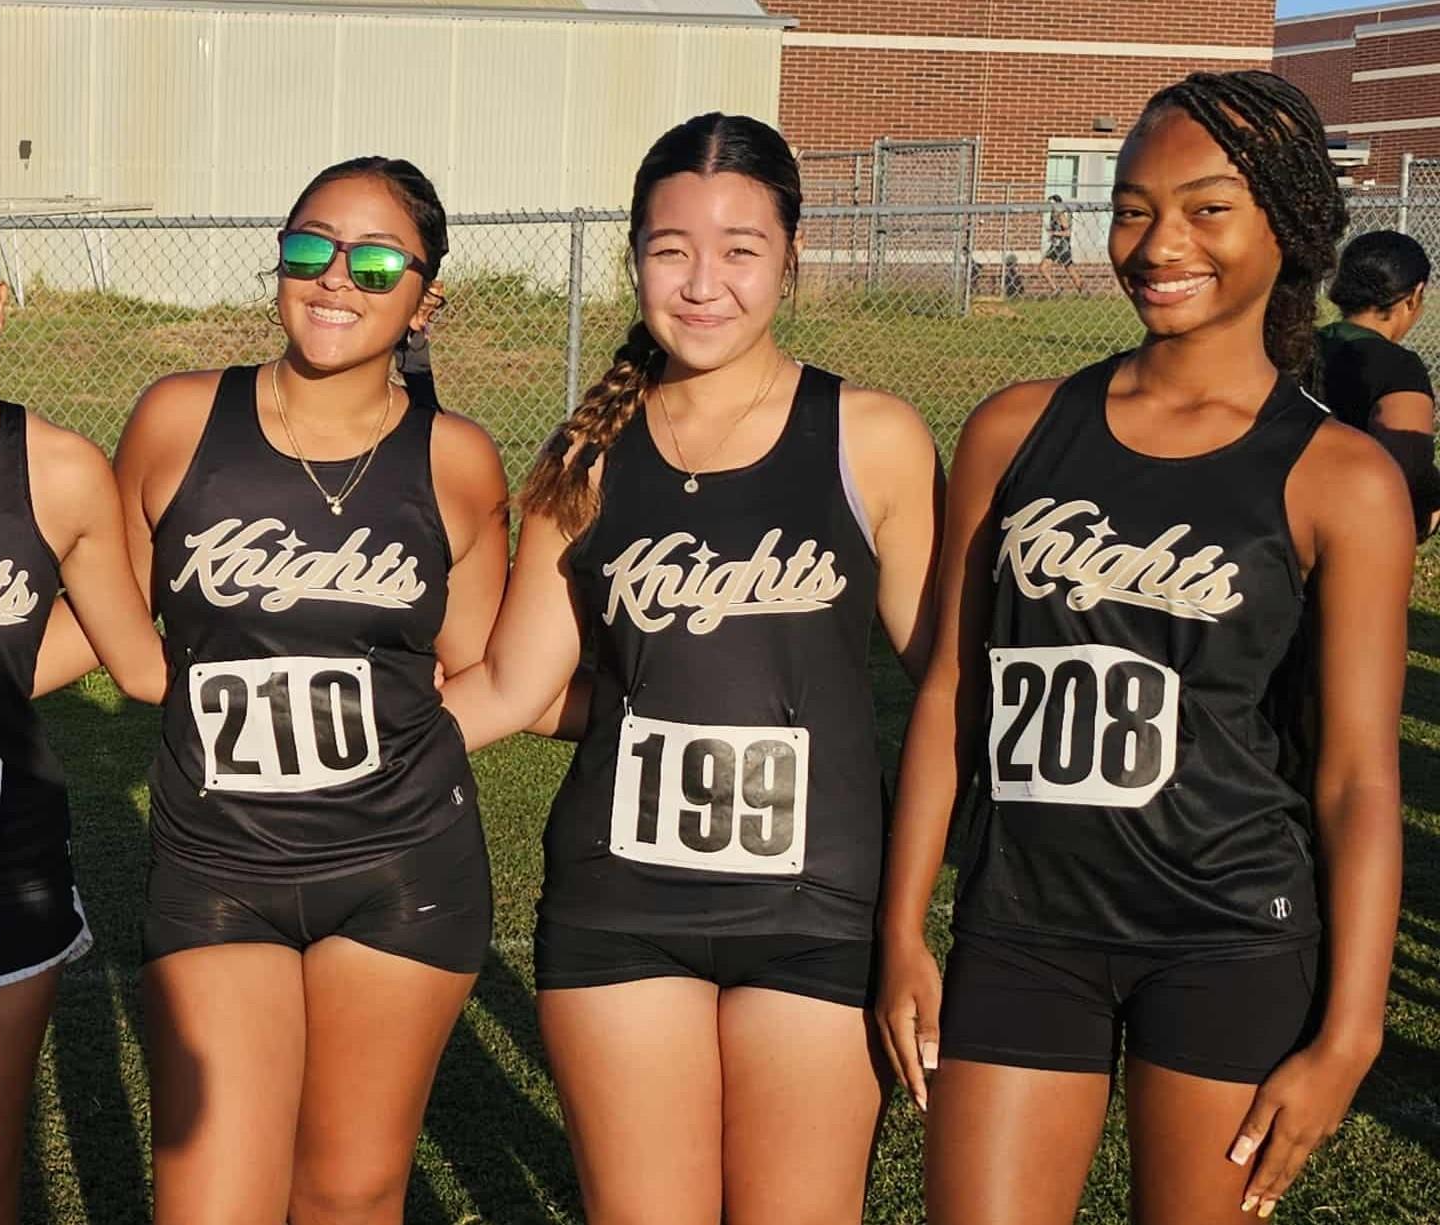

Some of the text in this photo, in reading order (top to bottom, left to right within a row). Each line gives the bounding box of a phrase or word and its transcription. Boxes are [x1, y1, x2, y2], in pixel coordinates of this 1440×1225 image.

[170, 518, 426, 612] Knights
[602, 528, 847, 635] Knights
[993, 497, 1244, 622] Knights
[199, 670, 369, 775] 210
[996, 659, 1166, 789] 208
[631, 732, 797, 857] 199
